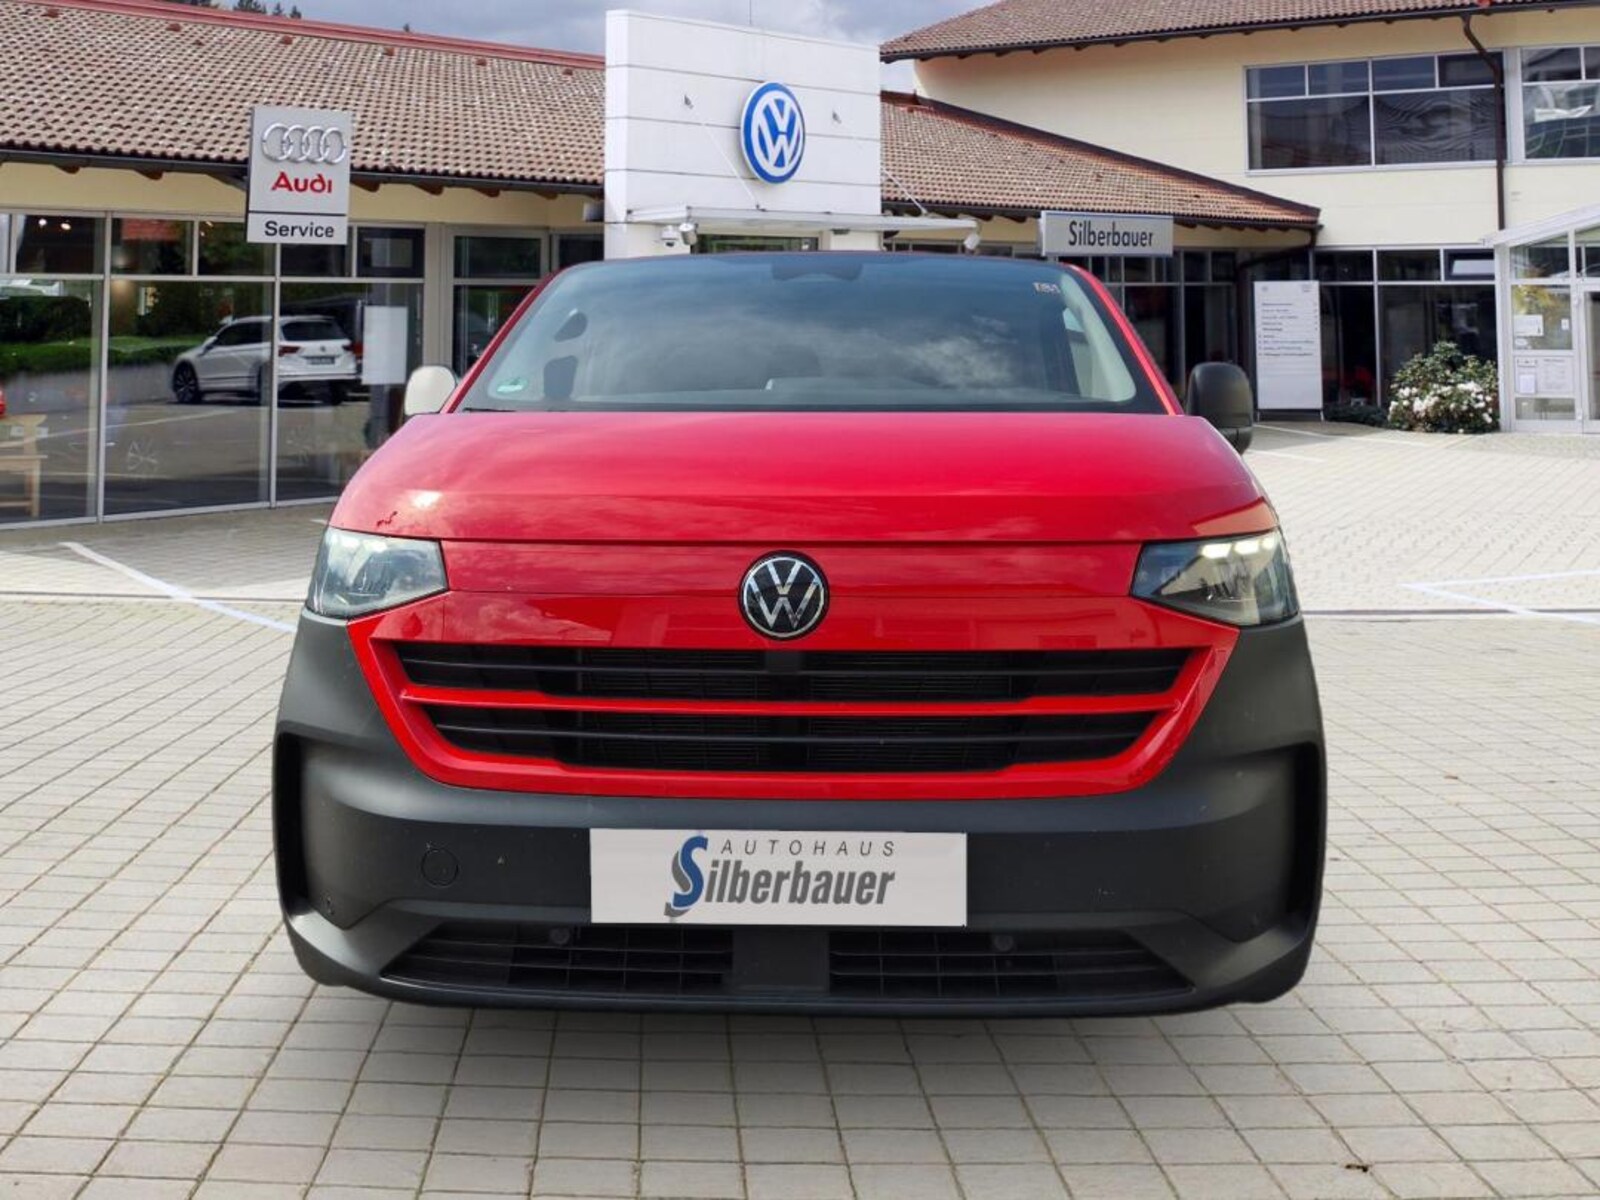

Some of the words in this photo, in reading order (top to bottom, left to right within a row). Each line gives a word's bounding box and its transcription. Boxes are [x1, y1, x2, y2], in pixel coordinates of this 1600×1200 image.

[270, 171, 333, 194] Audi
[264, 220, 335, 238] Service
[1068, 220, 1154, 247] Silberbauer
[746, 558, 822, 634] VW
[720, 839, 896, 856] AUTOHAUS
[664, 835, 896, 918] Silberbauer
